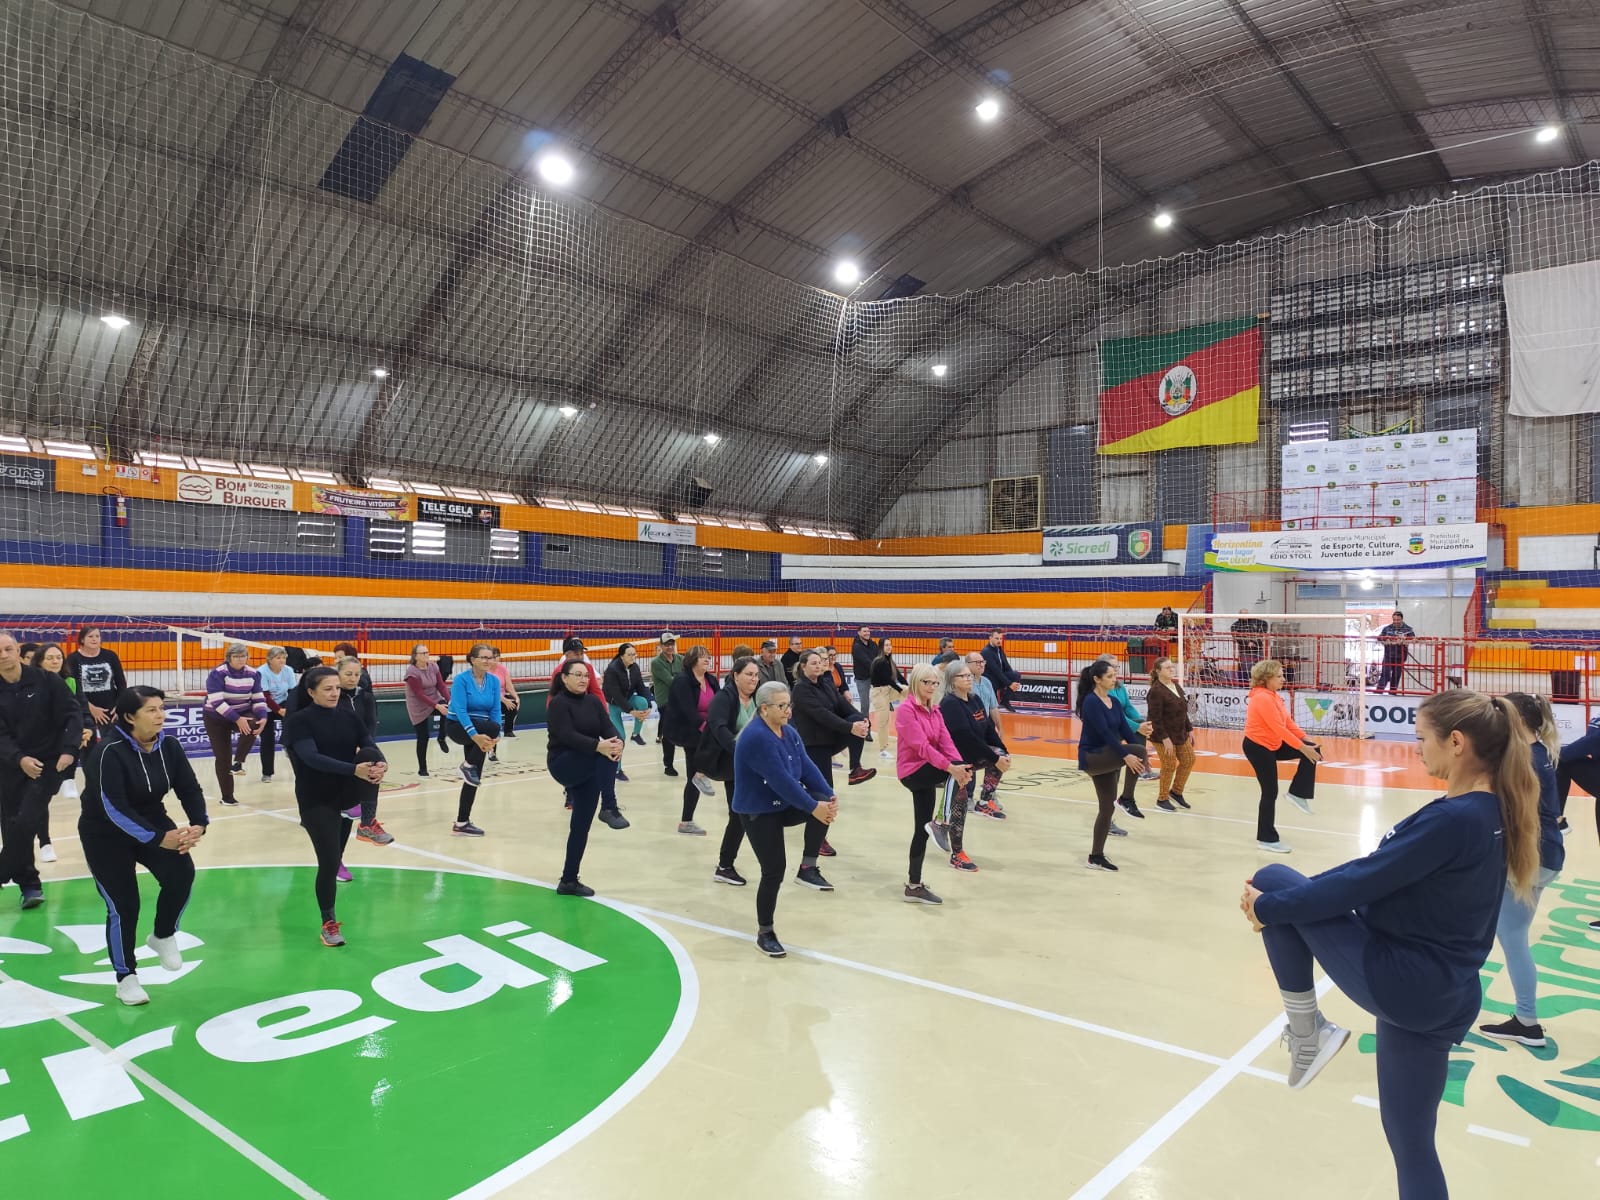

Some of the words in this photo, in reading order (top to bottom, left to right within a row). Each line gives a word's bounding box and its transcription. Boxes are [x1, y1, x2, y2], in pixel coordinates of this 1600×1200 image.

[223, 491, 287, 508] BURGUER
[329, 495, 366, 506] FRUTEIRA
[421, 501, 446, 512] TELE
[448, 504, 473, 515] GELA
[1354, 533, 1387, 542] Municipal
[1065, 541, 1111, 555] Sicredi
[1332, 542, 1366, 552] Esporte,
[1369, 541, 1402, 549] Cultura,
[1204, 693, 1240, 706] Tiago
